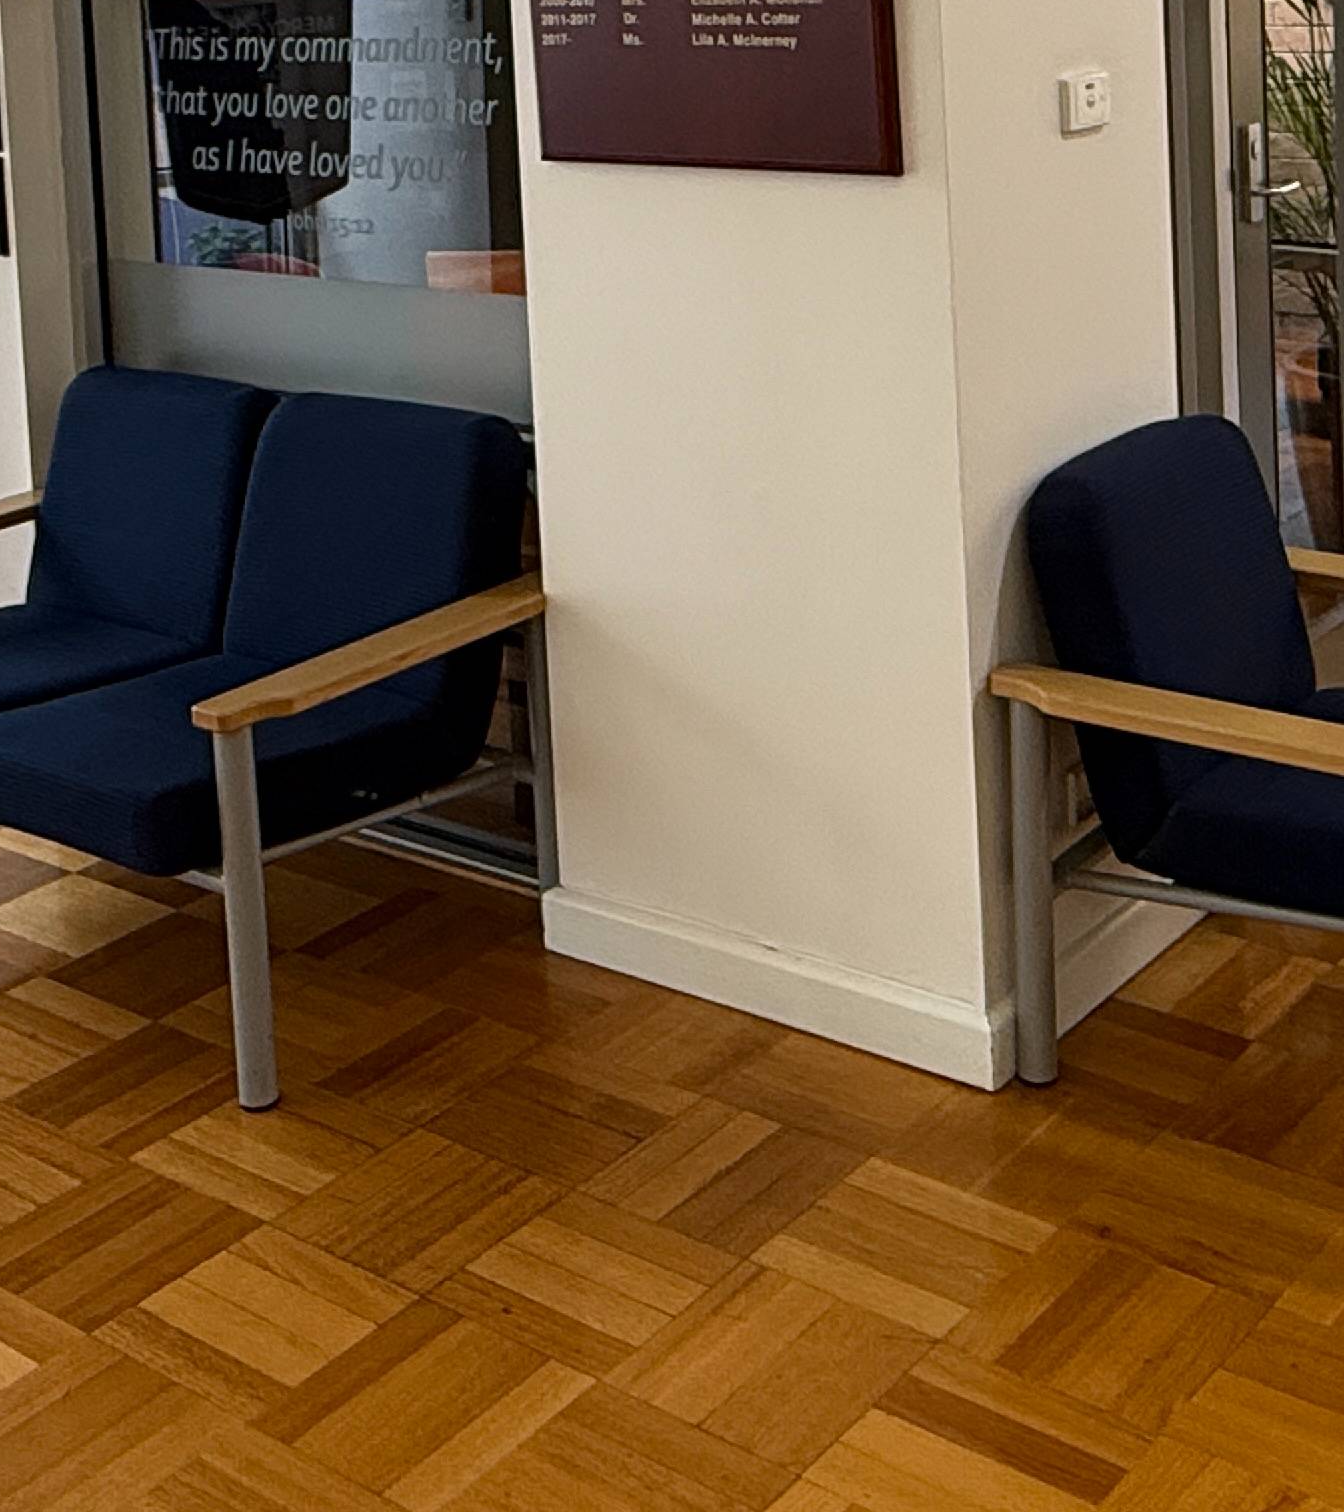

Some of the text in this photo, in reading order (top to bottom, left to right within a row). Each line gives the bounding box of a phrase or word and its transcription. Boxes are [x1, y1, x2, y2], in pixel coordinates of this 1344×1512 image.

[540, 13, 597, 27] 2011-2017
[622, 12, 640, 26] Dr.
[691, 12, 742, 26] Michelle
[745, 12, 759, 26] A.
[541, 33, 573, 46] 2017-
[717, 33, 729, 47] A.
[155, 27, 205, 61] This
[209, 28, 229, 61] is
[235, 36, 277, 72] my
[281, 27, 503, 75] commandment,
[158, 80, 499, 127] that you love one another
[191, 145, 220, 170] as
[225, 138, 236, 172] I
[240, 138, 302, 176] have
[308, 140, 384, 181] loved
